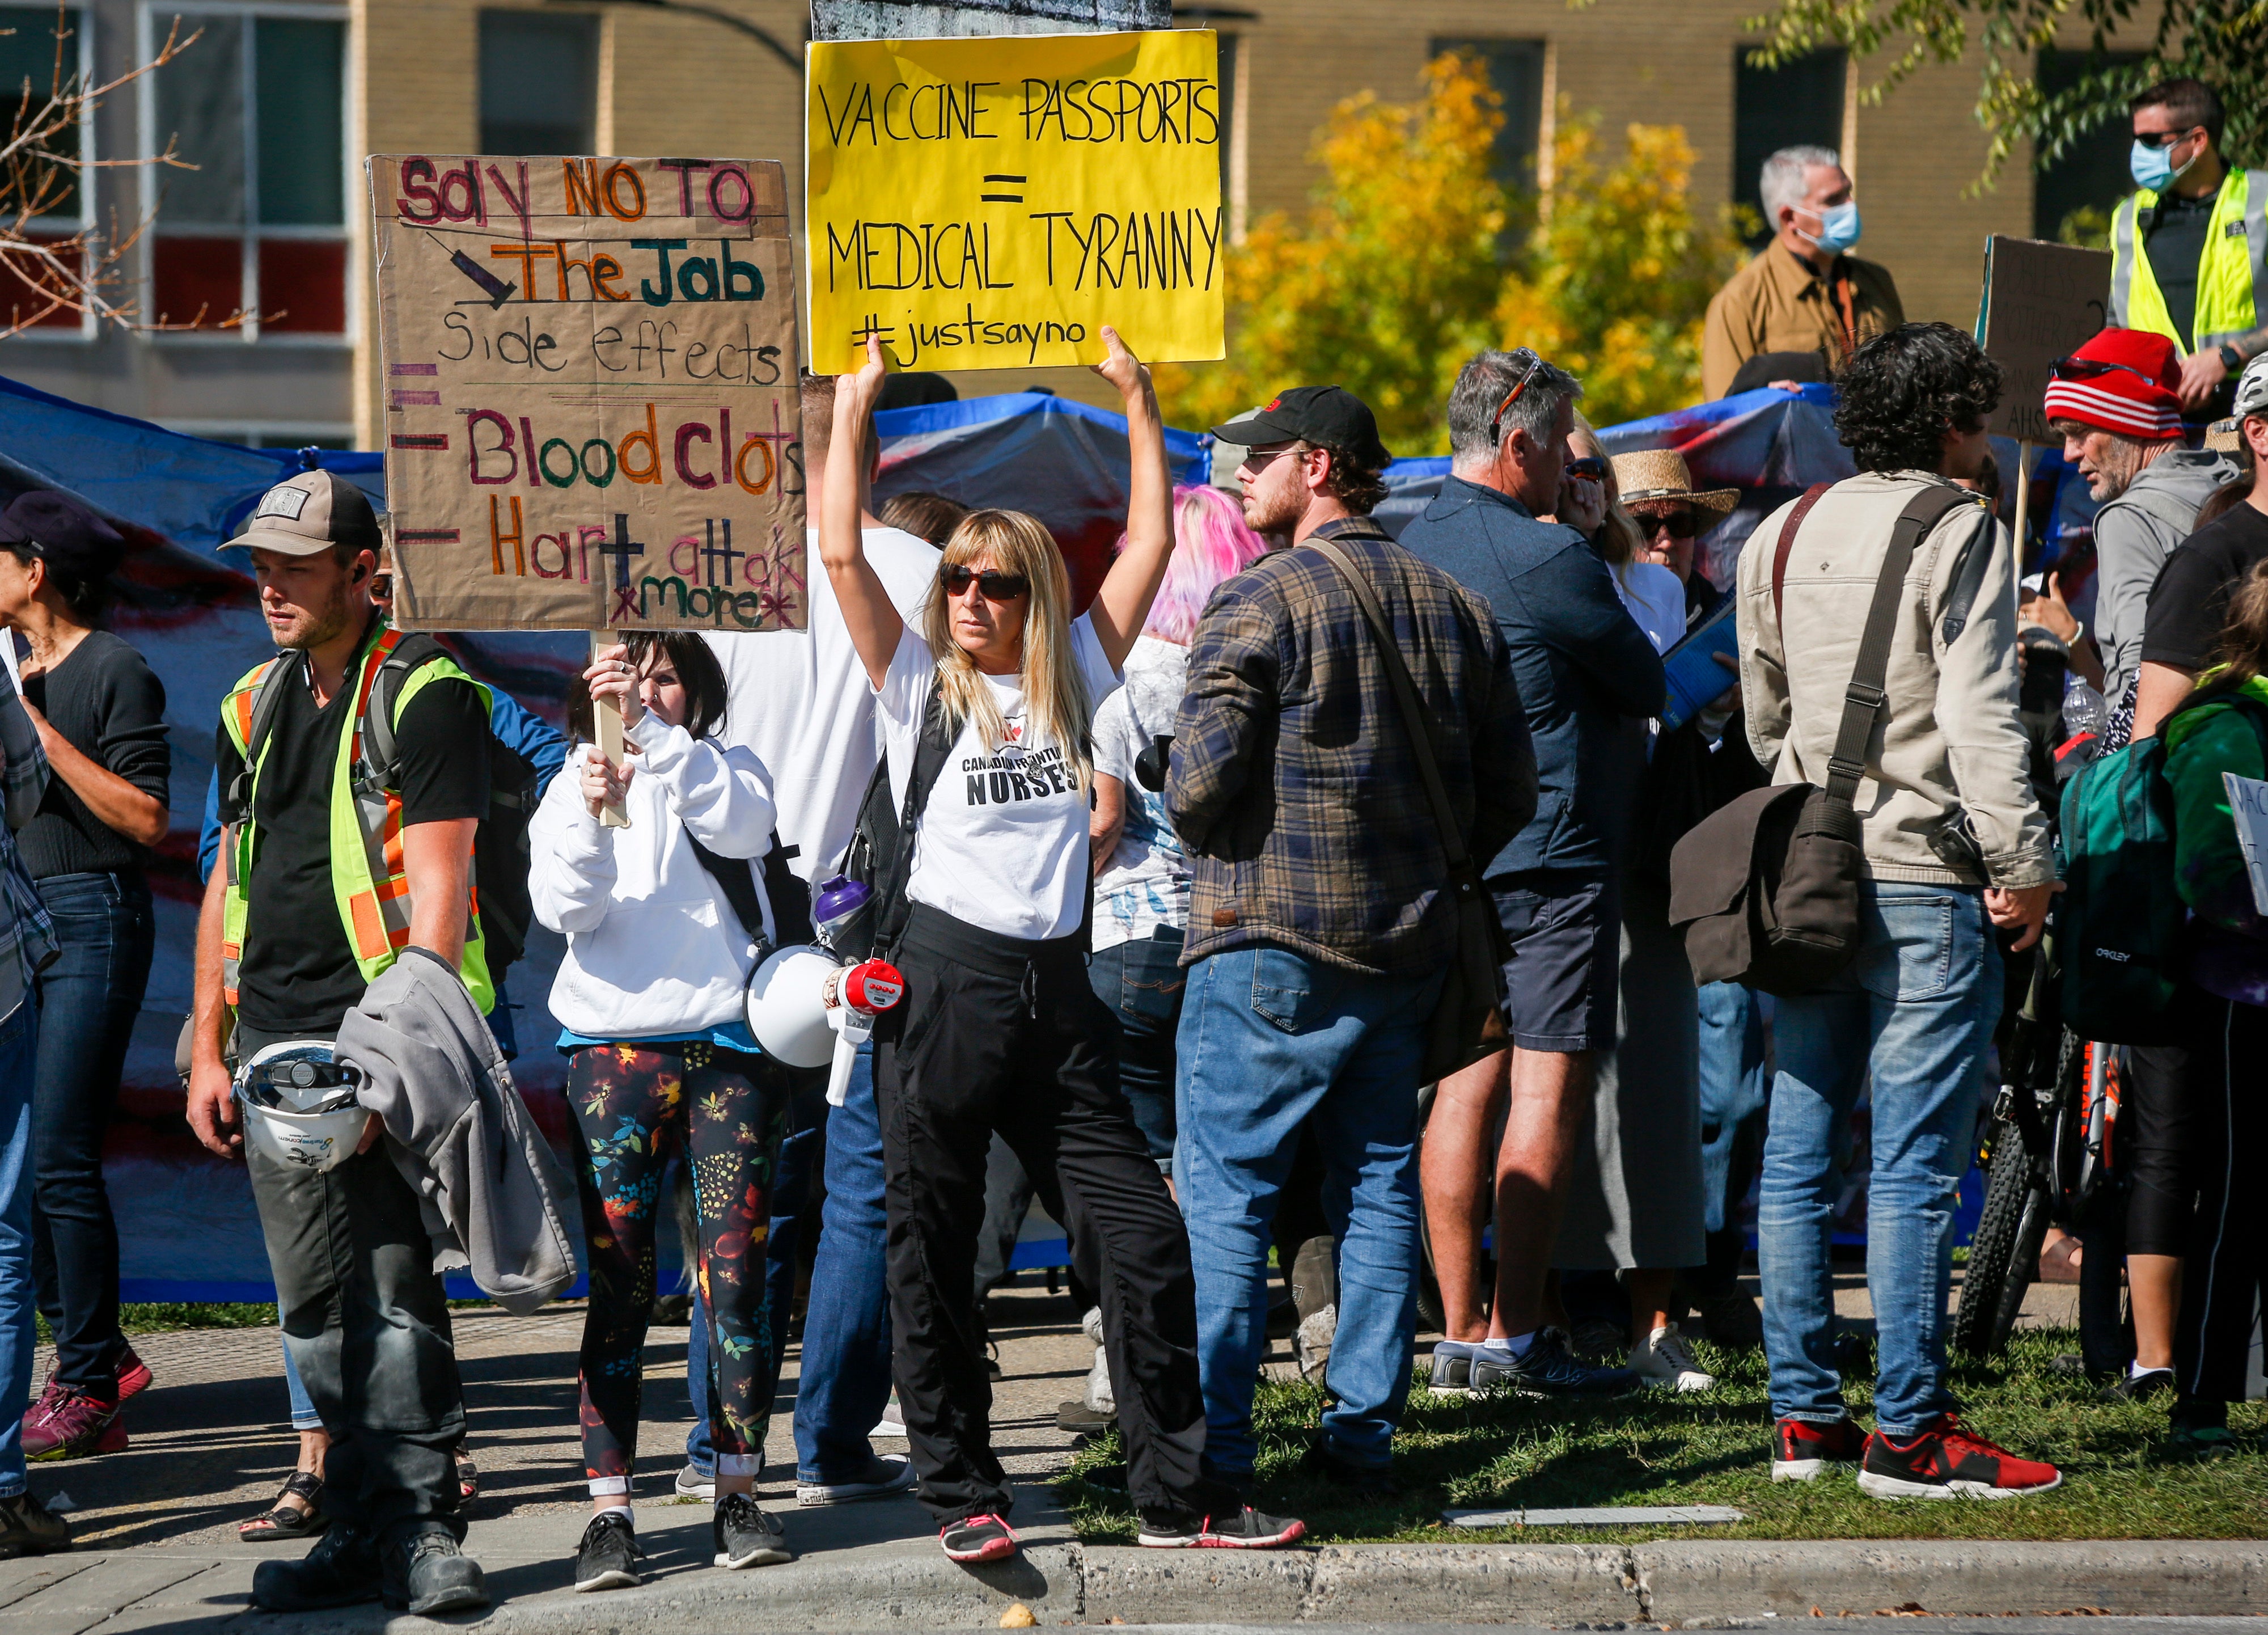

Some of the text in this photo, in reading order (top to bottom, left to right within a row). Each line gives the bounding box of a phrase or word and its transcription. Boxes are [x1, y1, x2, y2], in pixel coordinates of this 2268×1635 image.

[818, 78, 1220, 148] VACCINE PASSPORTS
[564, 158, 647, 222] NO
[658, 158, 756, 225] TO
[980, 175, 1027, 203] =
[491, 238, 765, 307] The Jab
[827, 206, 1222, 293] MEDICAL TYRANNY
[438, 311, 781, 386] Side effects
[851, 302, 1086, 367] #justsayno
[467, 403, 663, 488] Blood
[2007, 404, 2044, 438] AHS
[490, 493, 645, 588] Hart
[962, 756, 1015, 772] CANADIAN
[966, 761, 1078, 806] NURSES
[2096, 948, 2131, 962] OAKLEY
[810, 1495, 822, 1504] STAR
